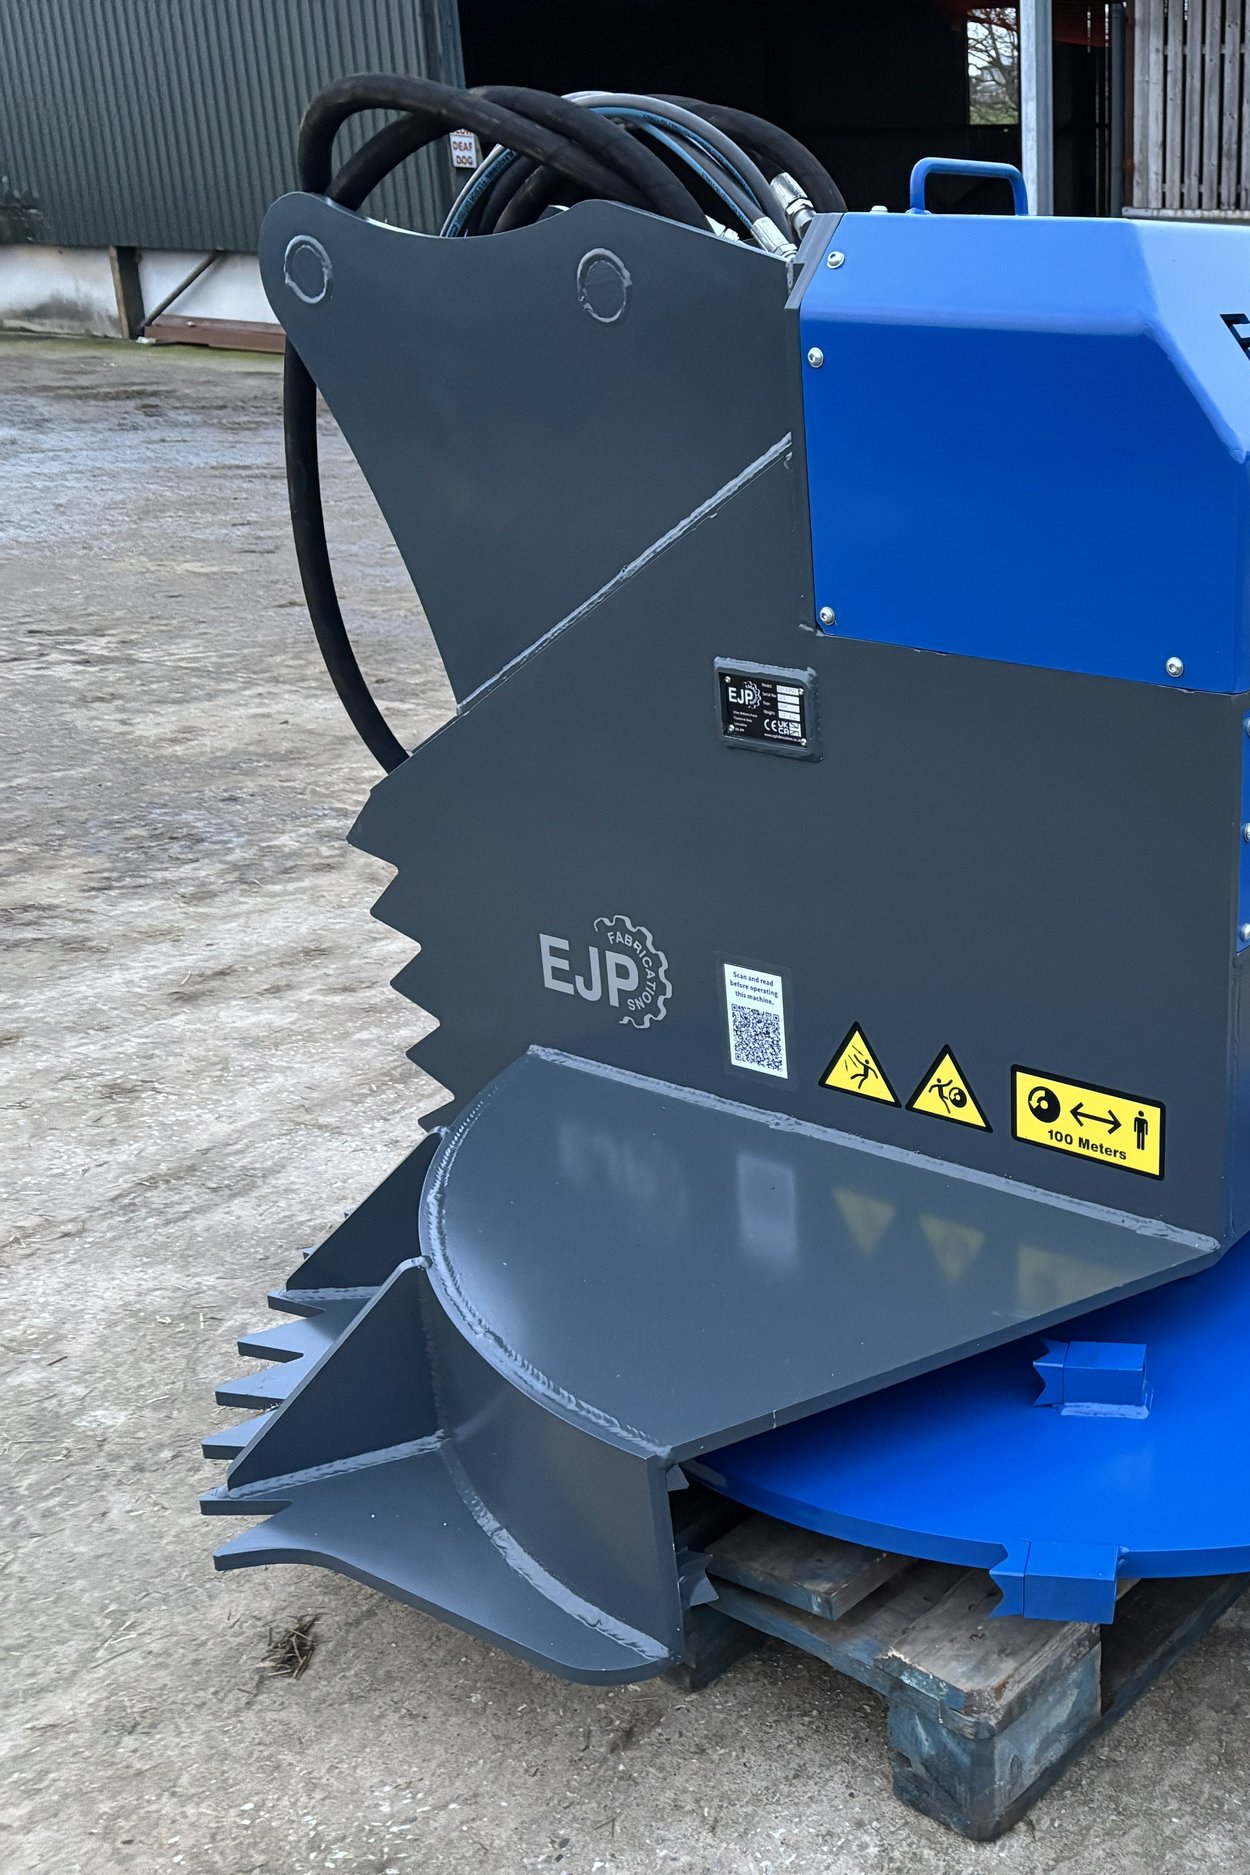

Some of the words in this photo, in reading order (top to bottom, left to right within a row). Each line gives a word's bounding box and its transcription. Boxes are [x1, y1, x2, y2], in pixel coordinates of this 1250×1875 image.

[452, 141, 473, 151] DEAF
[456, 156, 473, 165] DOG
[728, 686, 754, 705] EJP
[539, 933, 639, 1008] EJP
[607, 931, 656, 1011] FABRICATIONS
[733, 971, 747, 980] Scan
[730, 979, 748, 990] before
[750, 985, 779, 999] operating
[735, 990, 746, 998] this
[1047, 1129, 1073, 1145] 100
[1078, 1137, 1127, 1160] Meters
